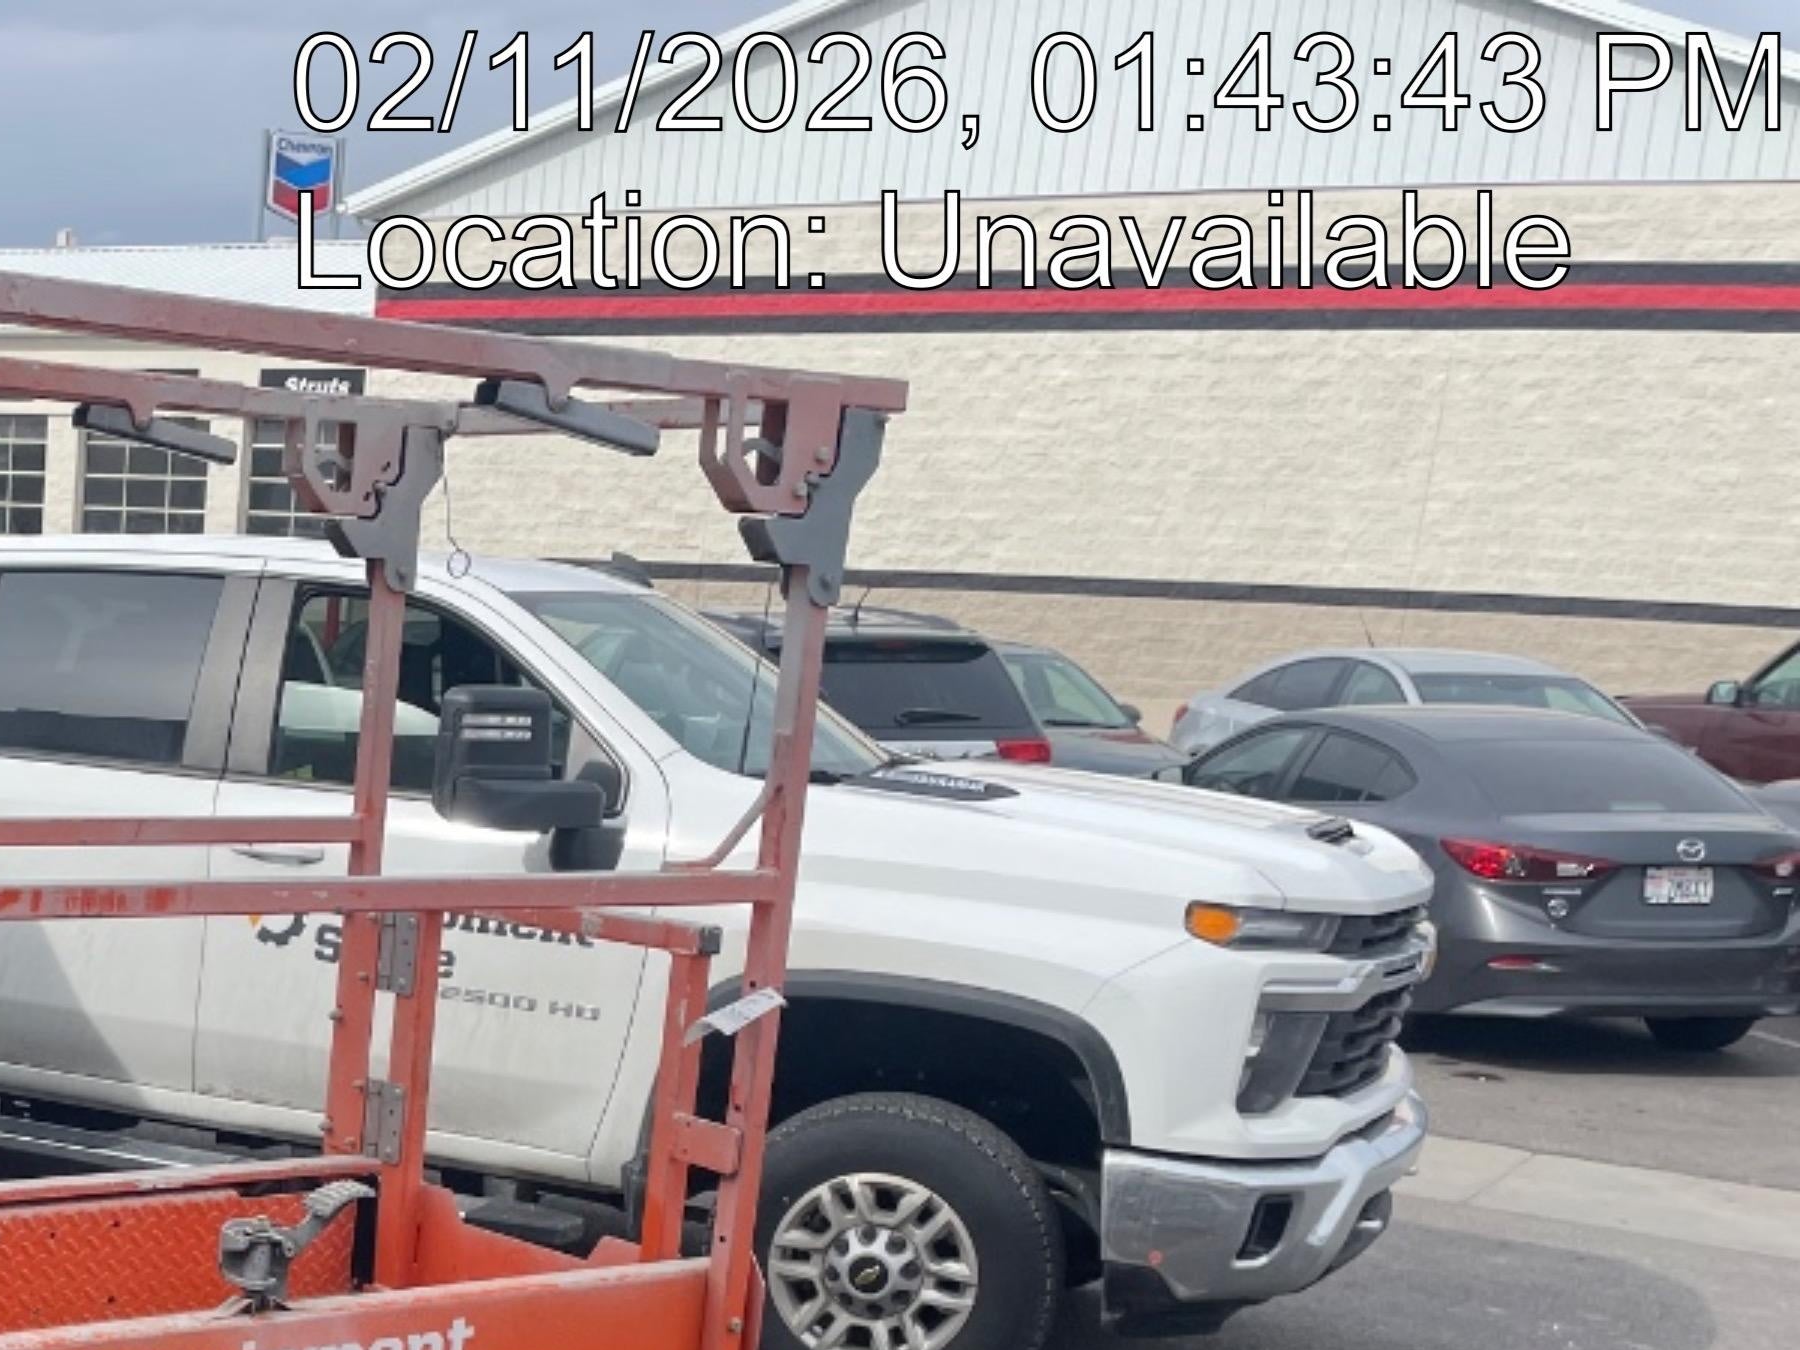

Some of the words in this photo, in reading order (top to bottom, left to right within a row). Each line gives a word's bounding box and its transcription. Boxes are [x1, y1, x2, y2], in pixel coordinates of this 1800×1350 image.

[285, 376, 352, 396] Struts
[440, 985, 538, 1012] 2500
[549, 1001, 601, 1021] HD
